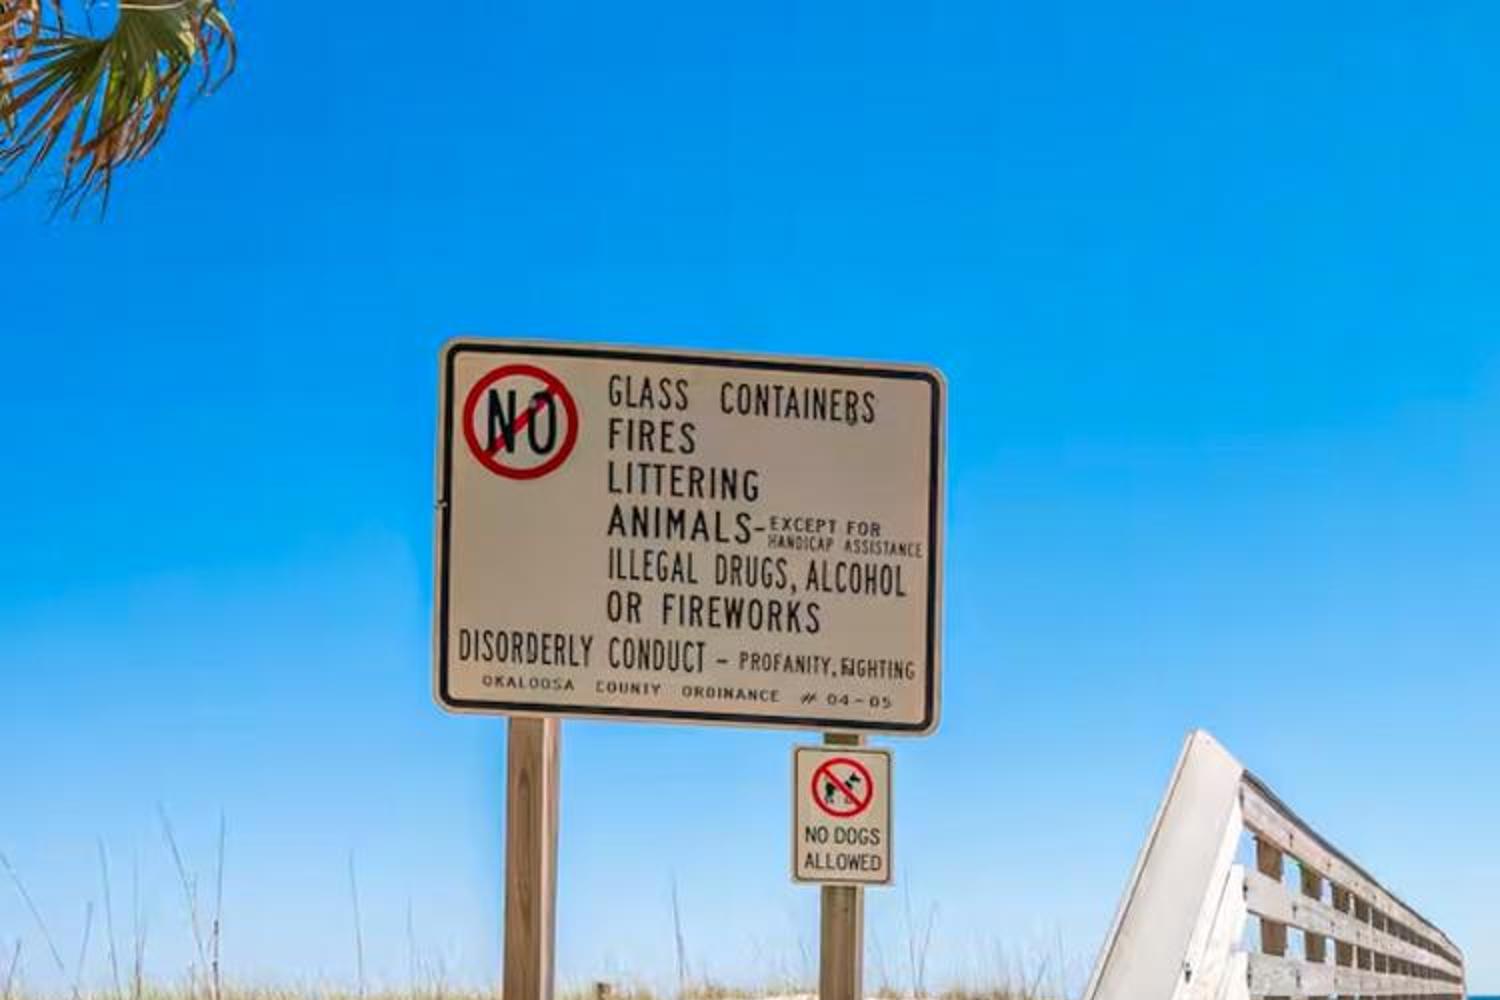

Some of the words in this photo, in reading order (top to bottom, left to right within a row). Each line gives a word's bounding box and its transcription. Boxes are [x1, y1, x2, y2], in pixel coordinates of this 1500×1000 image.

[608, 374, 690, 411] GLASS
[720, 381, 876, 427] CONTAINERS
[486, 389, 557, 455] NO
[608, 418, 696, 455] FIRES
[608, 461, 760, 502] LITTERING
[769, 515, 836, 534] EXCEPT
[847, 521, 881, 537] FOR
[767, 534, 834, 552] HANDICAP
[845, 540, 924, 558] ASSISTANCE
[608, 547, 699, 584] ILLEGAL
[715, 553, 797, 595] DRUGS,
[805, 559, 907, 597] ALCOHOL
[607, 590, 642, 624] OR
[662, 593, 821, 634] FIREWORKS
[459, 628, 593, 668] DISORDERLY
[608, 636, 706, 673] CONDUCT
[482, 675, 575, 691] OKALOOSA
[595, 680, 661, 695] COUNTY
[681, 685, 780, 703] ORDINANCE
[804, 826, 829, 844] NO
[833, 827, 881, 845] DOGS
[804, 852, 883, 871] ALLOWED
